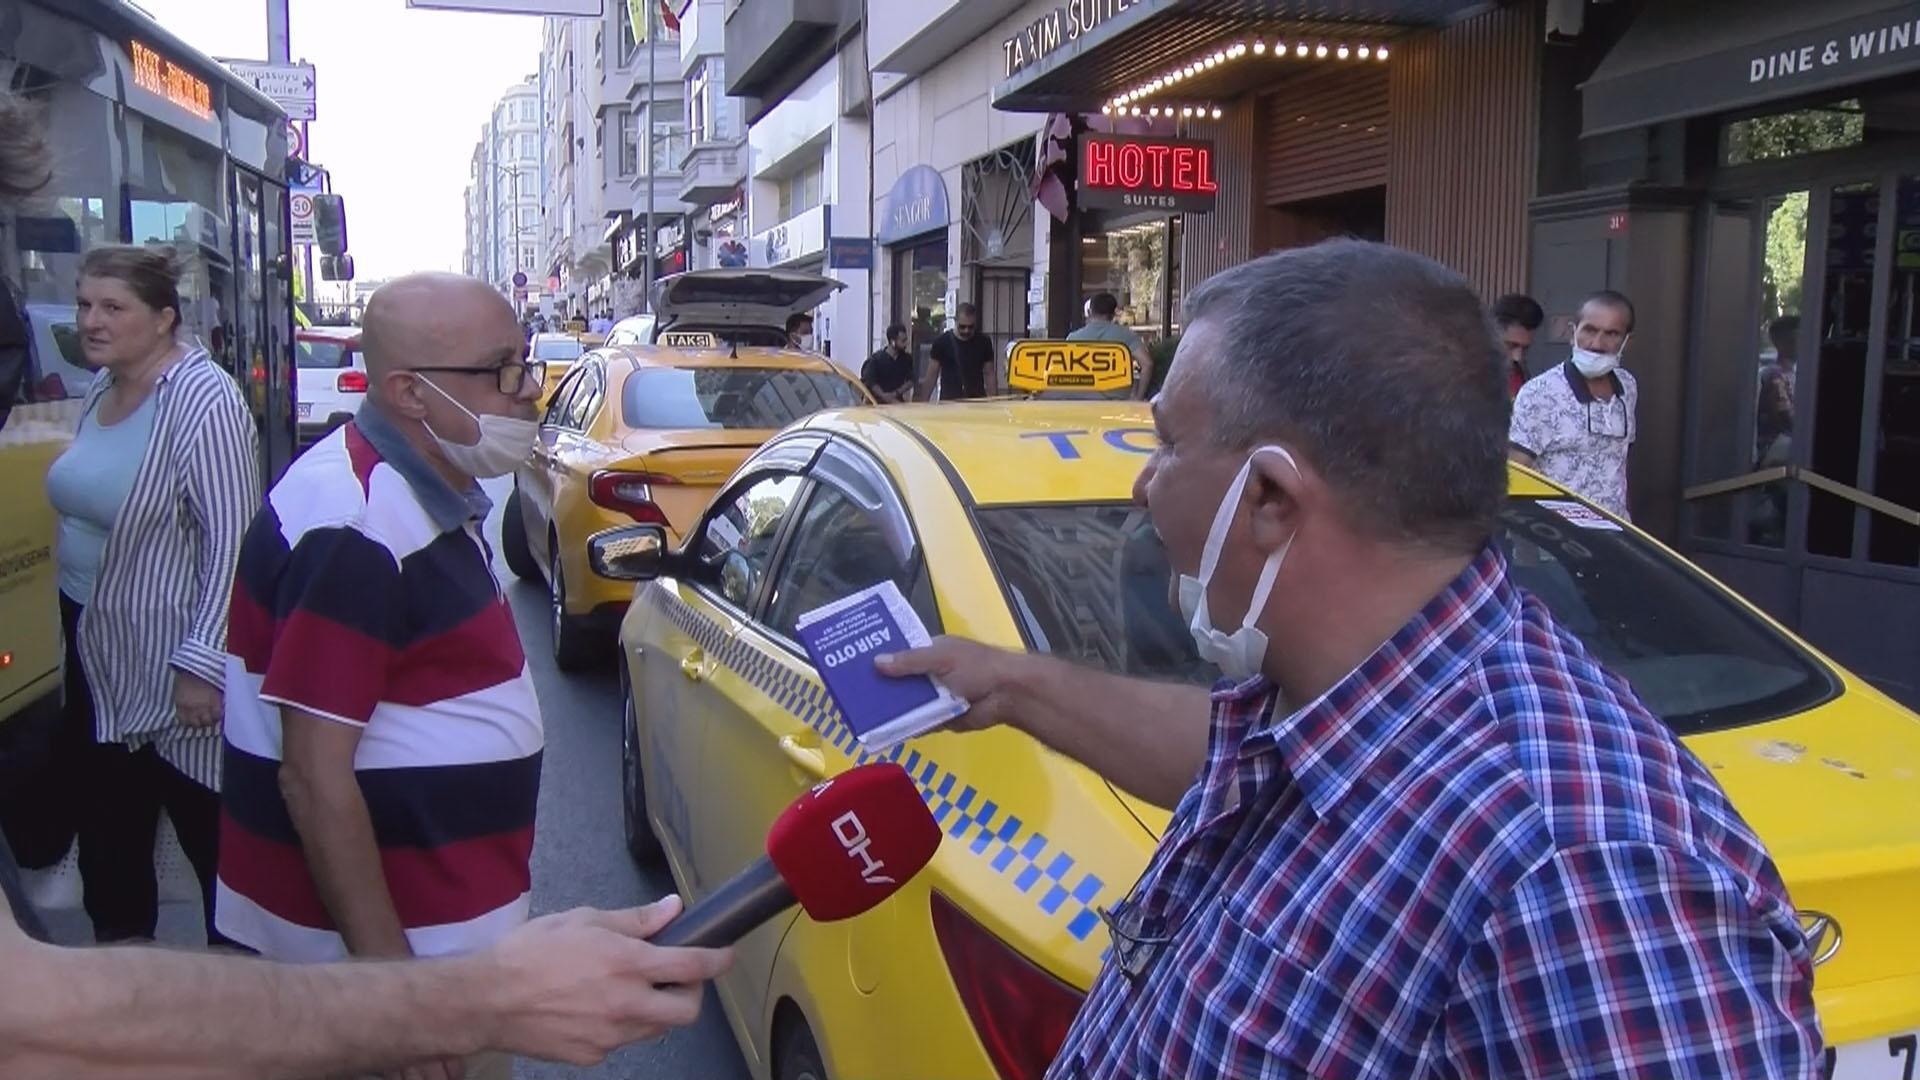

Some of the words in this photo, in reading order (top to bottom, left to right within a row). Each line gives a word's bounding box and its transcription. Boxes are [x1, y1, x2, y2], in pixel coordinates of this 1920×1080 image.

[1003, 10, 1062, 77] TAXIM
[1750, 46, 1815, 82] DINE
[1821, 40, 1840, 66] &
[1088, 141, 1217, 191] HOTEL
[294, 201, 308, 213] 50
[1123, 194, 1176, 207] SUITES
[824, 644, 857, 668] OTO
